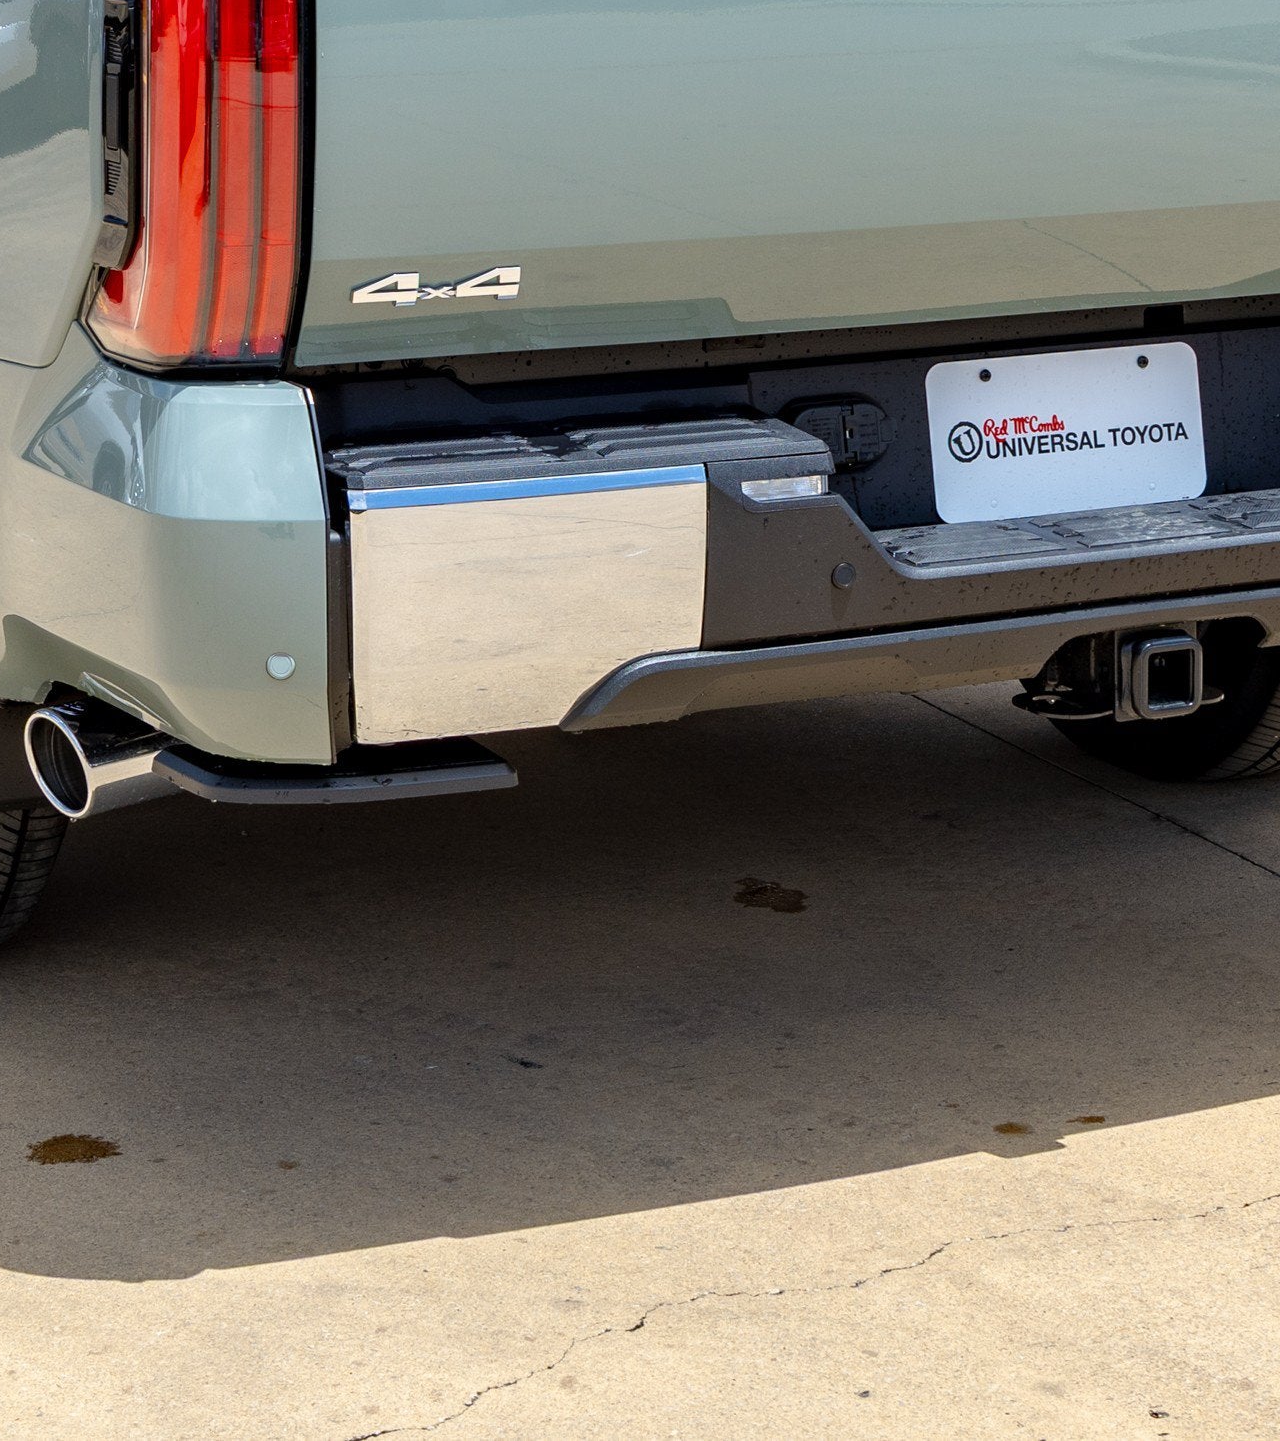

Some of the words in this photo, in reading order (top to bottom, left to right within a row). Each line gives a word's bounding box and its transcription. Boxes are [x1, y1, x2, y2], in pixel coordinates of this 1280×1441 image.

[350, 265, 521, 307] 4x4
[983, 418, 1008, 443] Red
[1009, 414, 1064, 434] McCombs
[986, 430, 1105, 459] UNIVERSAL
[1108, 421, 1189, 446] TOYOTA
